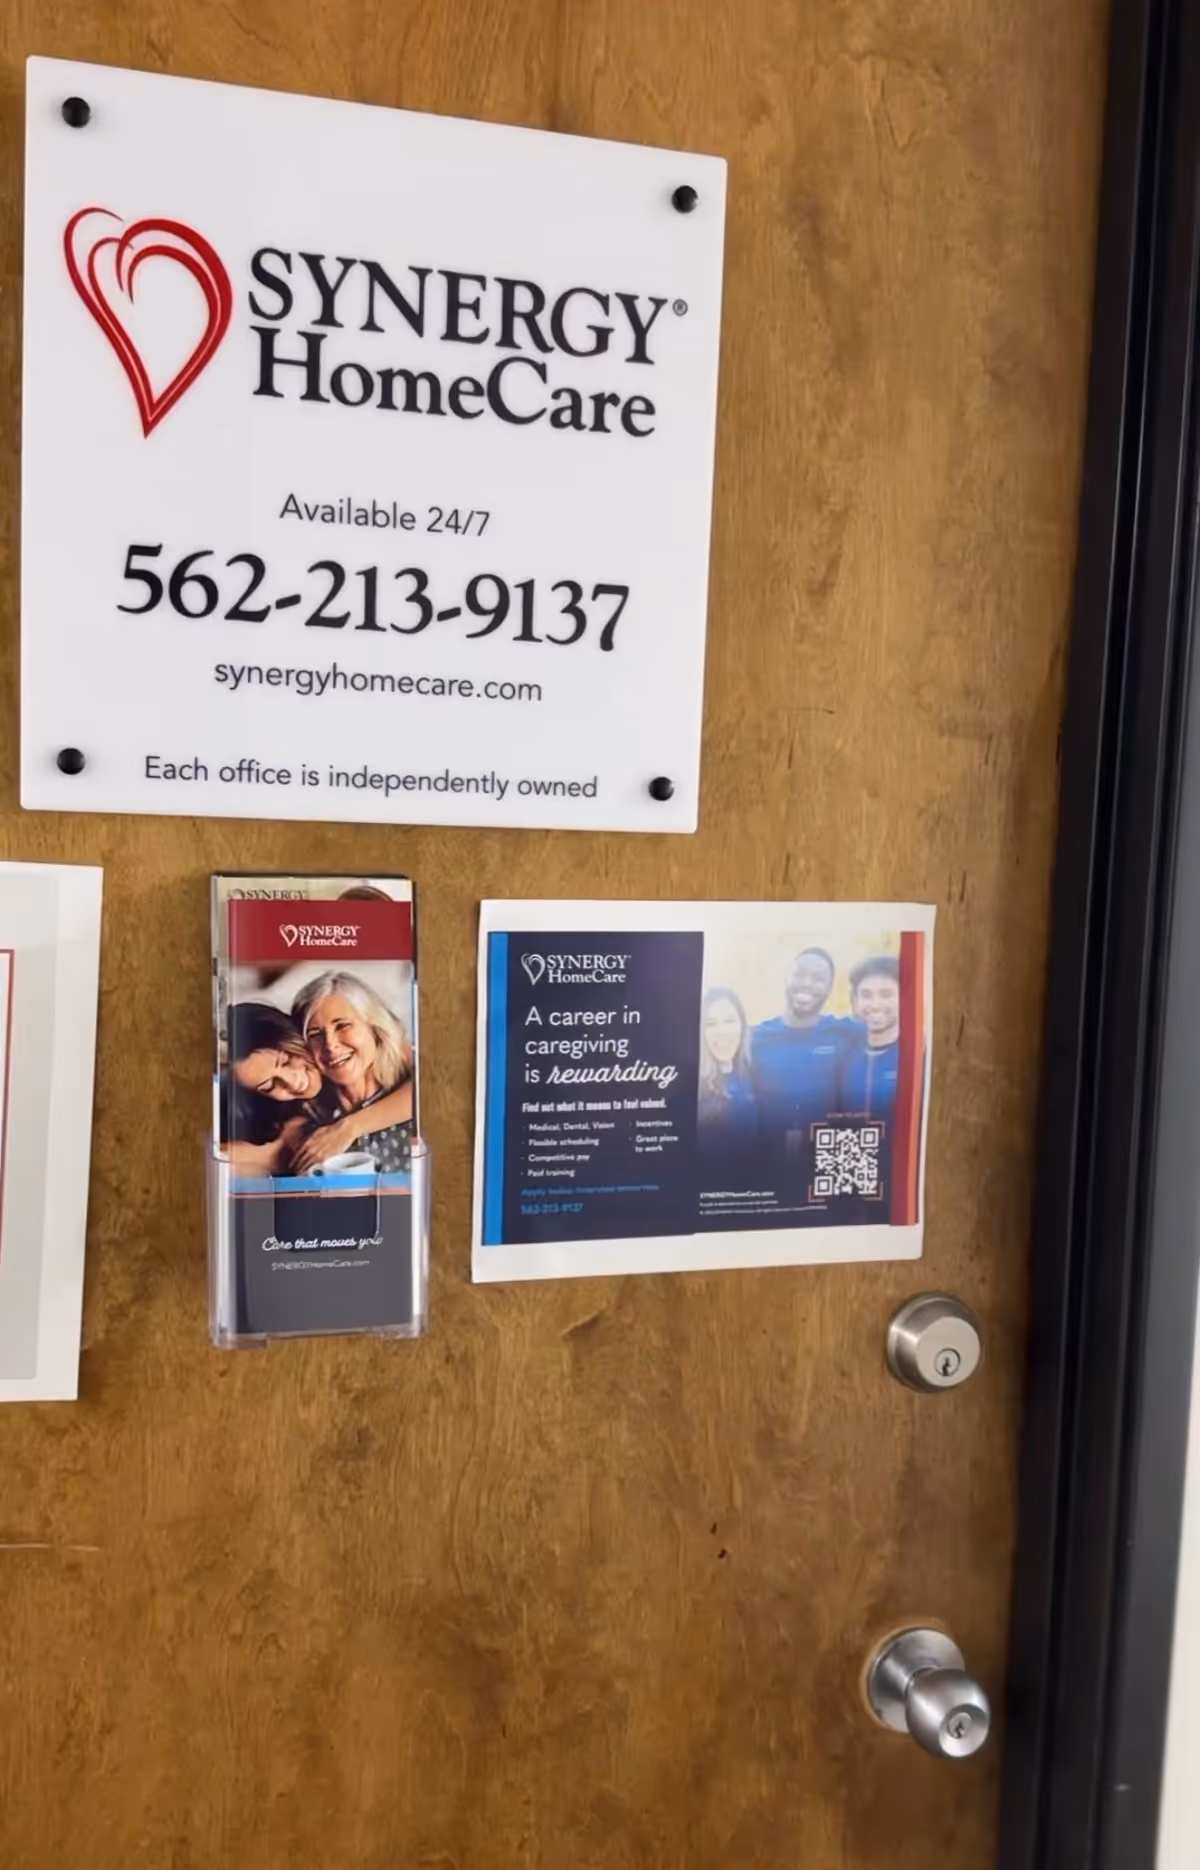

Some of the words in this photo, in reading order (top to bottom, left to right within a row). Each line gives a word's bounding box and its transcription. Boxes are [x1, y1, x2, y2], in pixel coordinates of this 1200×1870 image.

[250, 325, 657, 438] HomeCare
[279, 493, 416, 533] Available
[426, 506, 491, 538] 24/7
[116, 543, 630, 652] 562-213-9137
[214, 660, 543, 702] synergyhomecare.com
[144, 755, 208, 783] Each
[218, 757, 292, 788] office
[301, 763, 320, 788] is
[328, 762, 510, 800] independently
[516, 774, 598, 799] owned
[246, 889, 305, 900] SYNERGY
[298, 925, 358, 937] SYNERGY
[300, 936, 358, 946] HomeCare
[548, 970, 627, 983] HomeCare
[525, 1006, 543, 1026] A
[549, 1010, 616, 1025] career
[623, 1005, 641, 1025] in
[525, 1034, 629, 1059] caregiving
[525, 1063, 540, 1083] is
[546, 1060, 678, 1088] rewarding
[522, 1102, 539, 1112] Find
[541, 1102, 555, 1111] out
[557, 1101, 576, 1111] what
[578, 1101, 584, 1111] it
[613, 1101, 622, 1110] to
[529, 1122, 561, 1131] Medical,
[563, 1122, 591, 1131] Dental,
[592, 1121, 615, 1129] Vision
[636, 1119, 673, 1127] Incentives
[529, 1138, 557, 1146] Flexible
[560, 1137, 600, 1147] scheduling
[635, 1135, 658, 1143] Great
[635, 1145, 643, 1153] to
[645, 1144, 663, 1152] work
[528, 1153, 575, 1162] Competitive
[576, 1154, 590, 1163] pay
[528, 1168, 544, 1177] Paid
[546, 1168, 575, 1178] training
[262, 1236, 293, 1251] Care
[294, 1237, 318, 1249] that
[320, 1237, 356, 1248] moves
